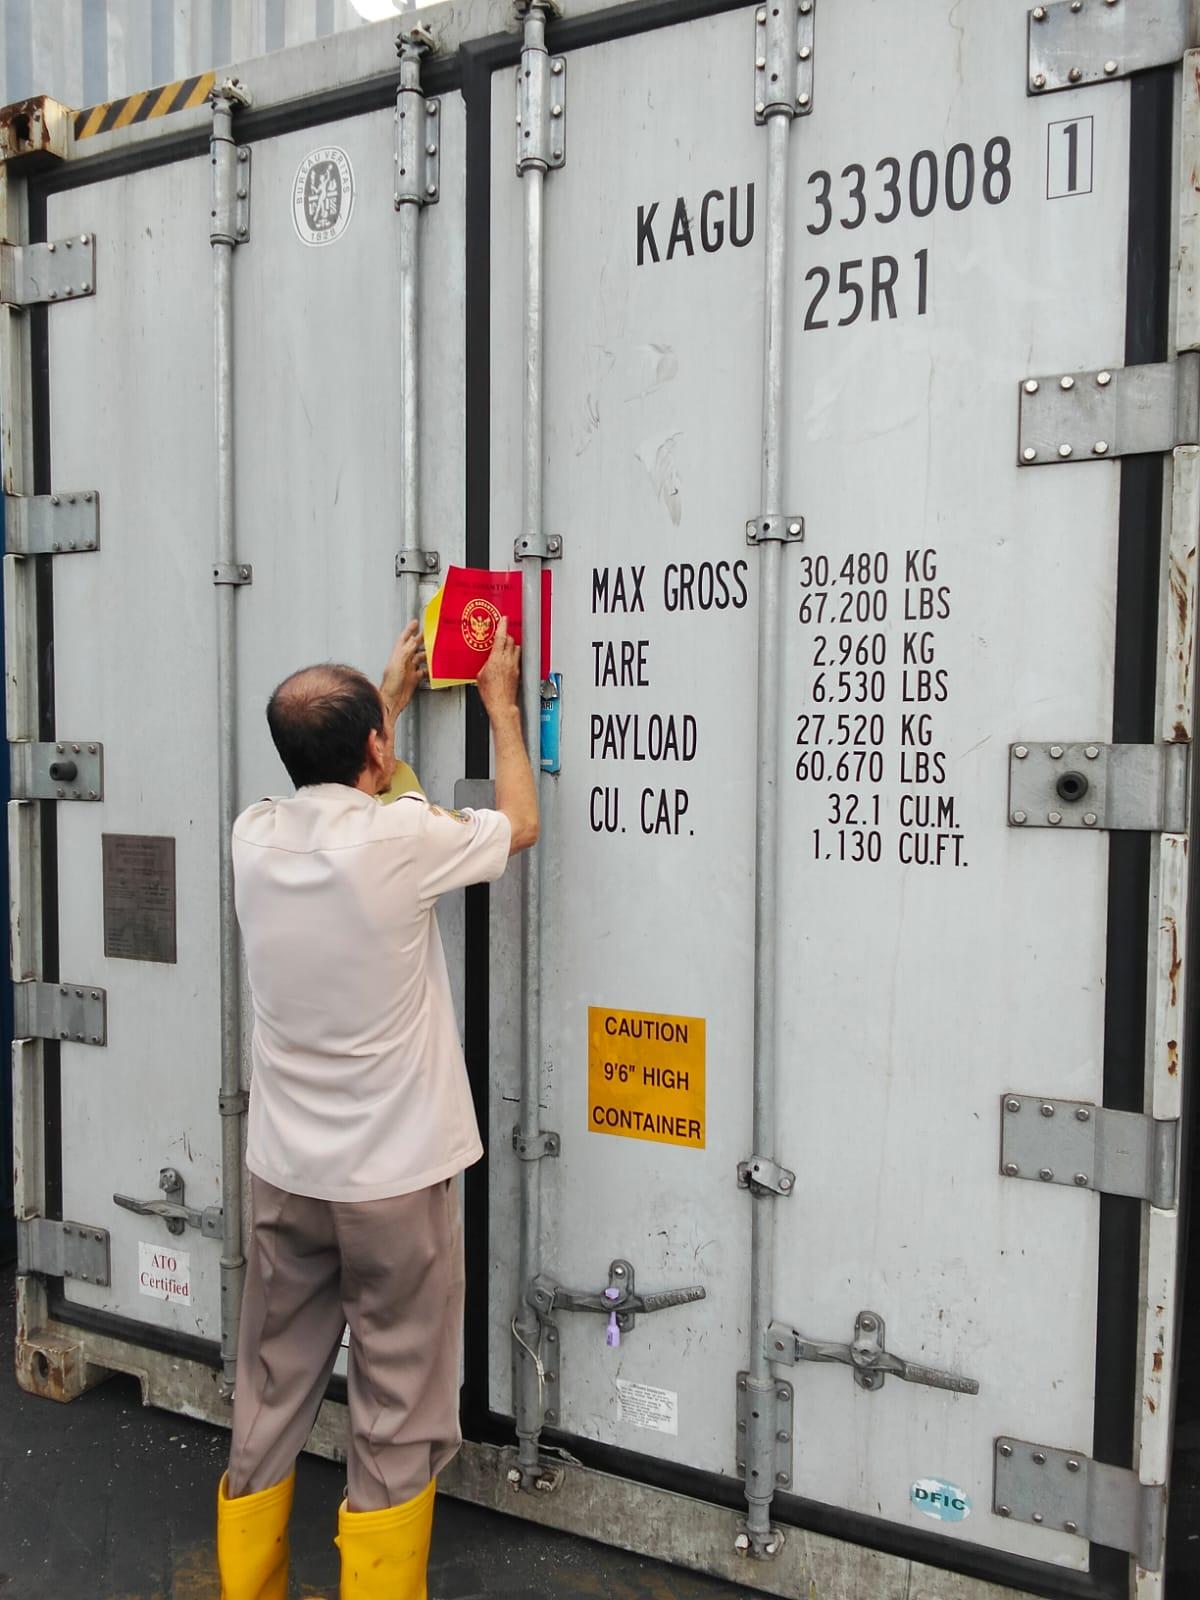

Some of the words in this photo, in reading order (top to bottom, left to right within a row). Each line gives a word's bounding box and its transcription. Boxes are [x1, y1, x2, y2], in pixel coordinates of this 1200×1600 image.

[296, 154, 321, 204] BUREAU
[324, 151, 350, 193] VERITAS
[637, 183, 755, 266] KAGU
[806, 137, 1012, 236] 333008
[1062, 123, 1078, 193] 1
[803, 248, 928, 331] 25R1
[800, 551, 888, 588] 30,480
[905, 548, 938, 583] KG
[592, 565, 646, 614] MAX
[663, 559, 749, 613] GROSS
[799, 588, 888, 624] 67,200
[904, 586, 951, 620] LBS
[591, 640, 650, 687] TARE
[812, 633, 887, 667] 2,960
[903, 631, 935, 665] KG
[812, 670, 886, 704] 6,530
[902, 669, 949, 703] LBS
[590, 713, 698, 762] PAYLOAD
[795, 713, 885, 747] 27,520
[901, 713, 933, 747] KG
[795, 750, 884, 784] 60,670
[900, 751, 947, 784] LBS
[589, 786, 627, 834] CU.
[640, 787, 695, 837] CAP.
[827, 793, 881, 826] 32.1
[899, 794, 961, 829] CU.M.
[812, 828, 882, 863] 1,130
[899, 832, 969, 868] CU.FT.
[604, 1016, 689, 1044] CAUTION
[603, 1062, 636, 1083] 9'6"
[643, 1066, 689, 1091] HIGH
[592, 1105, 702, 1140] CONTAINER
[151, 1253, 177, 1272] ATO
[140, 1272, 189, 1296] Certified
[915, 1488, 966, 1511] DFIC
